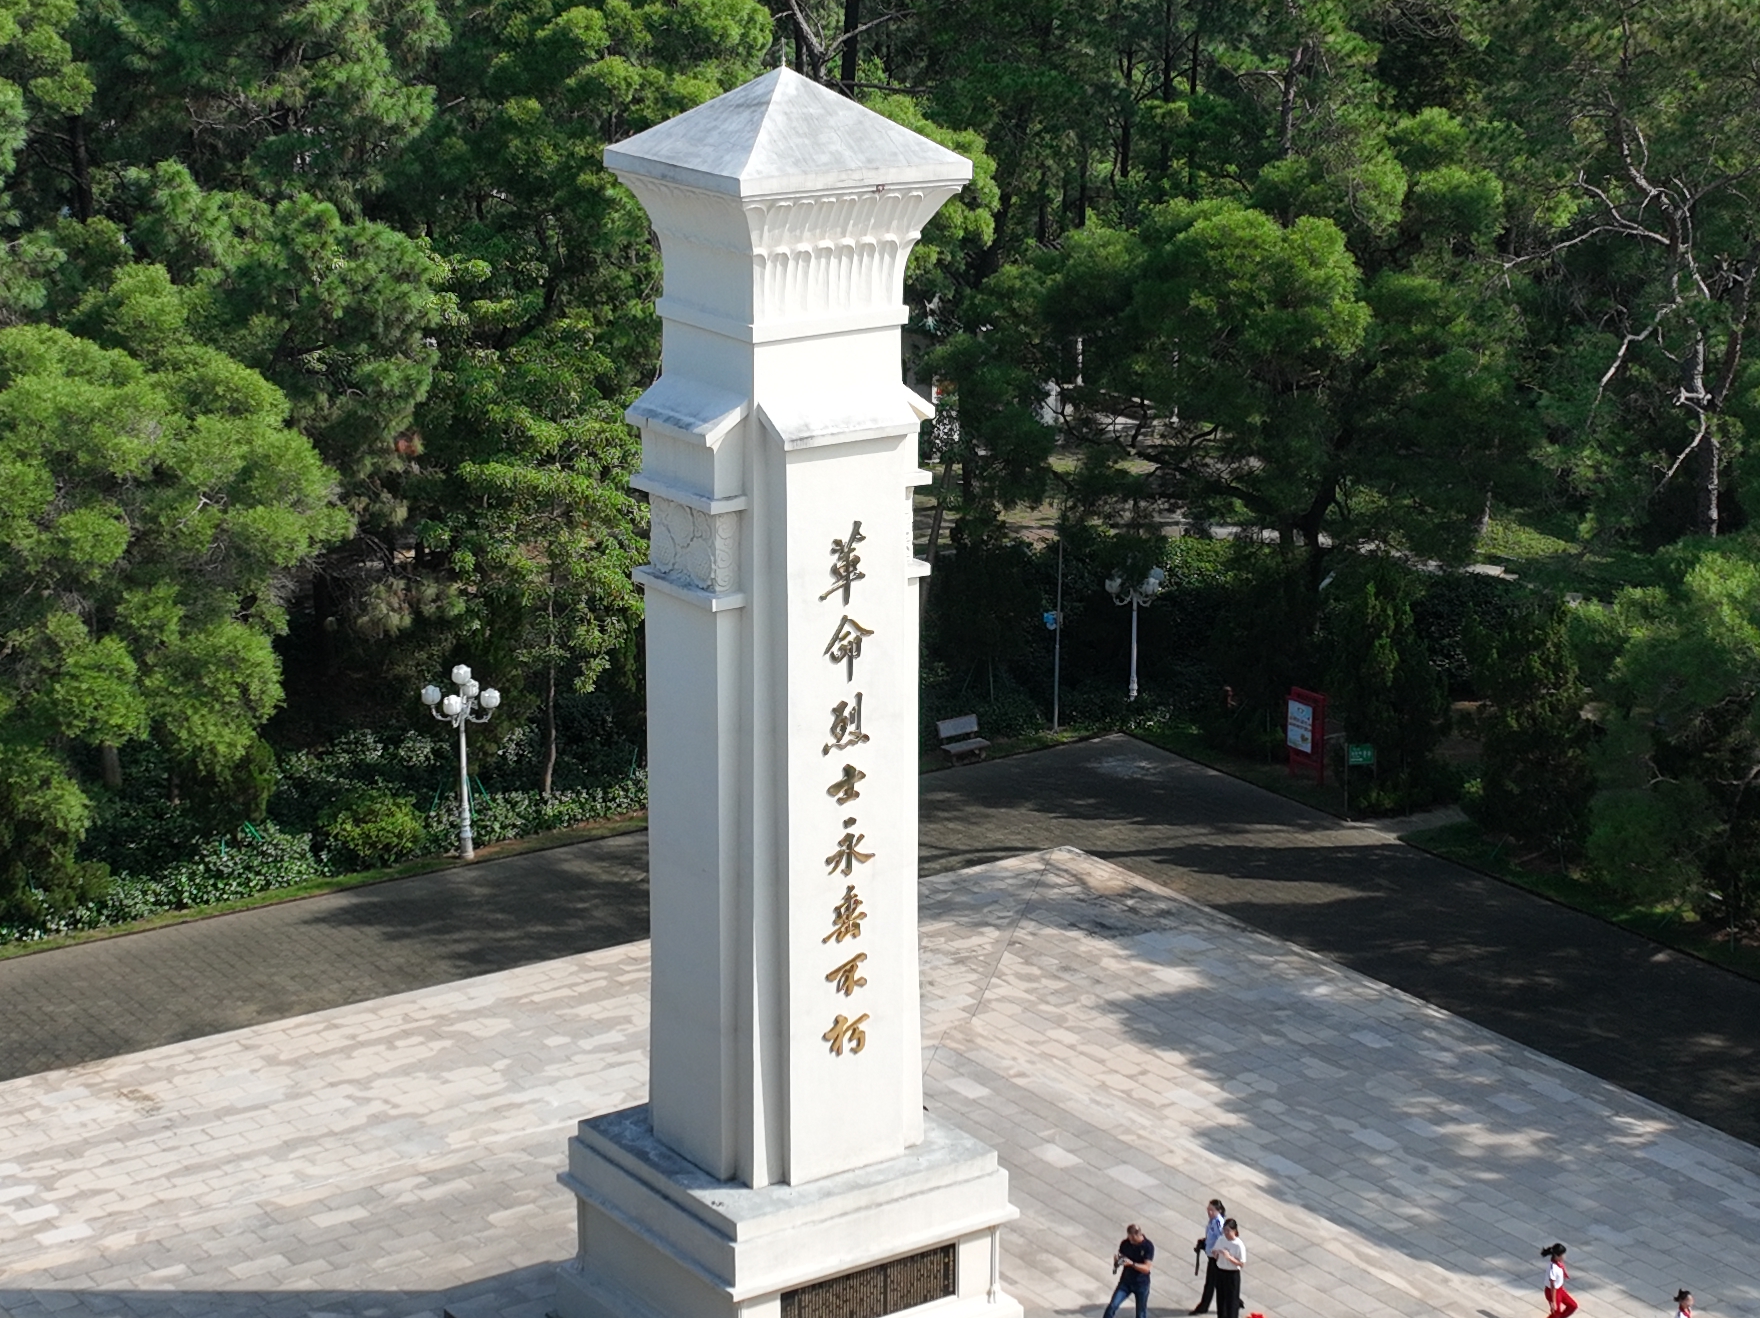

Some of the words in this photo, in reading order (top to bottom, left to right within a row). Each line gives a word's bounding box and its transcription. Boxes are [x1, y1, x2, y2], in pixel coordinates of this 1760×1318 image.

[819, 520, 875, 1056] 革命烈士永垂不朽
